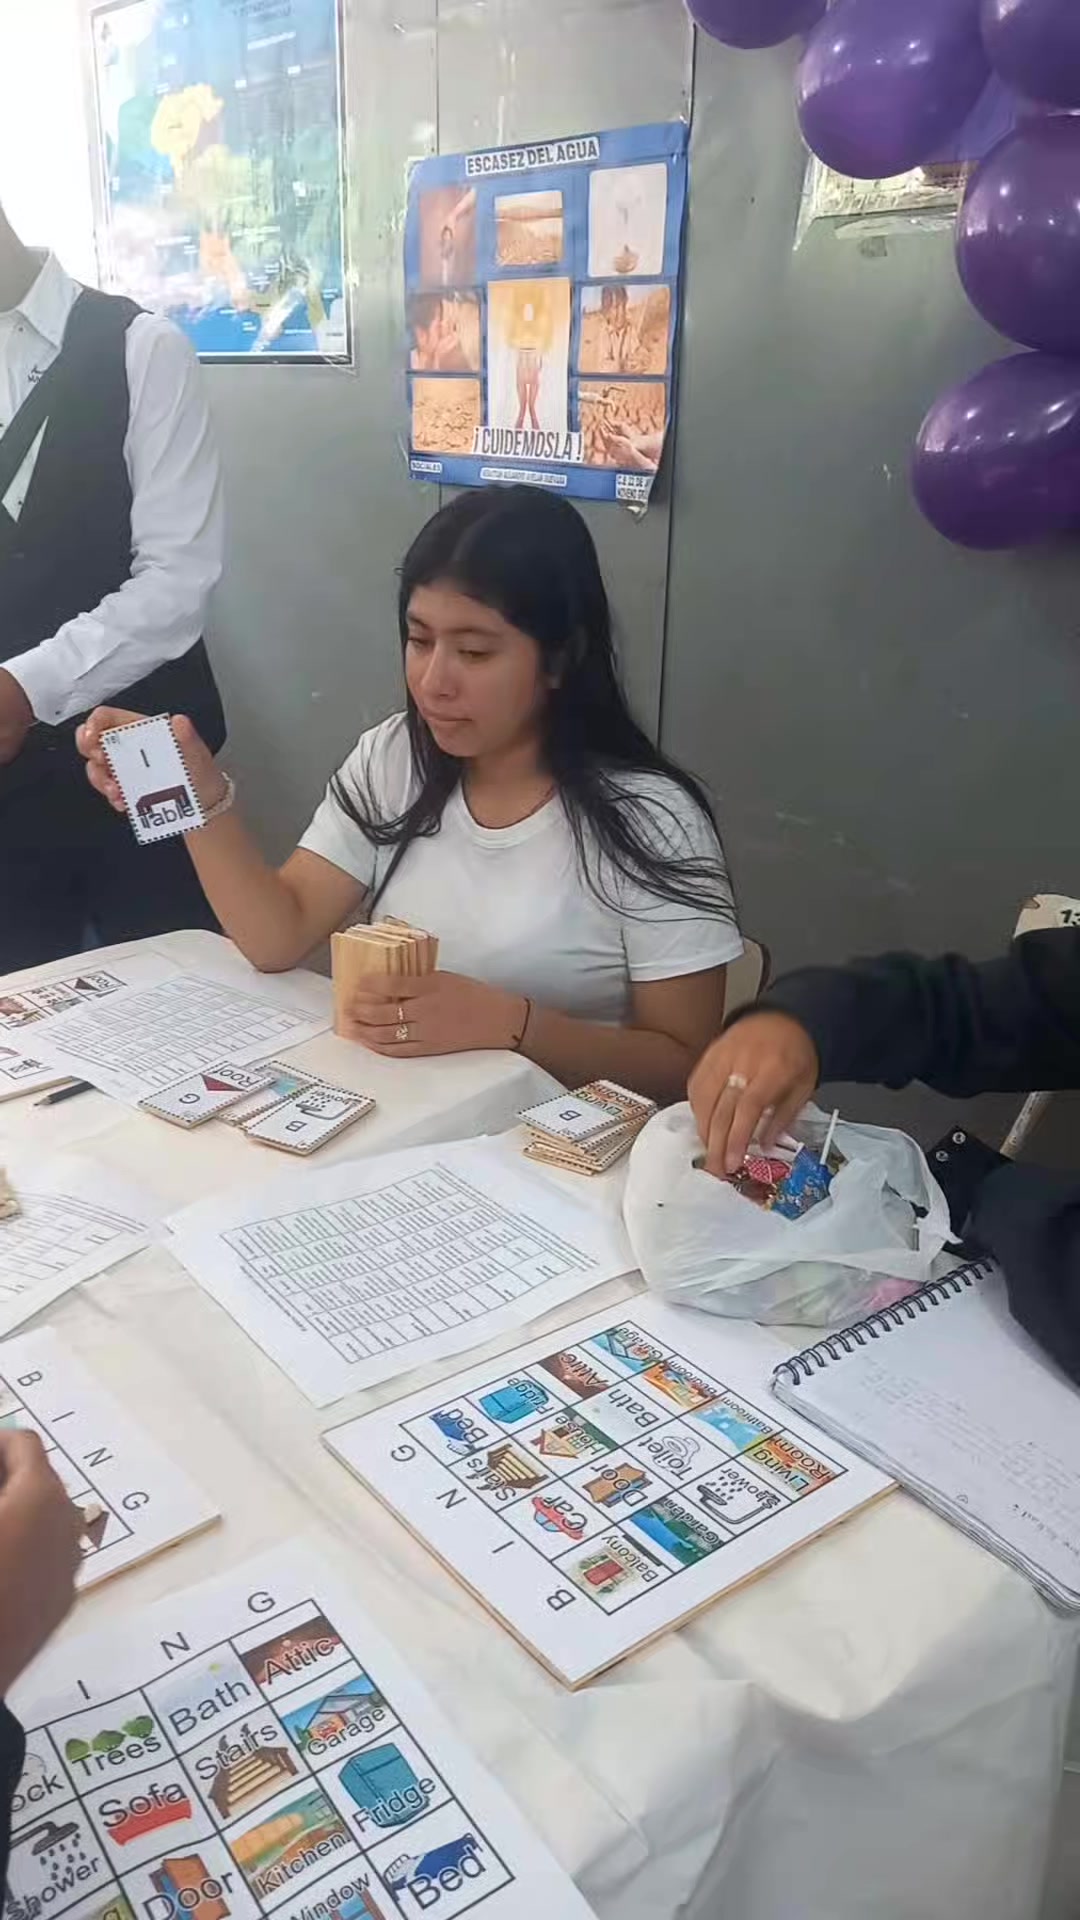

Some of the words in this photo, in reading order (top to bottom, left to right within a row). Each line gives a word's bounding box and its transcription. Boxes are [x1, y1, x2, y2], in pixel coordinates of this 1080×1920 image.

[467, 151, 525, 174] ESCASEZ
[527, 147, 553, 166] DEL
[556, 140, 598, 162] AGUA
[137, 797, 196, 830] Table
[211, 1065, 260, 1088] Roof
[178, 1092, 201, 1105] G
[559, 1109, 582, 1121] B
[285, 1119, 309, 1133] B
[620, 1327, 664, 1364] Garage
[559, 1351, 611, 1387] Attic
[507, 1376, 554, 1415] Fridge
[608, 1388, 660, 1429] Bath
[723, 1396, 774, 1435] Bathroom
[17, 1371, 43, 1387] B
[83, 1447, 113, 1468] N
[122, 1491, 149, 1511] G
[441, 1407, 489, 1444] Bed
[555, 1414, 606, 1456] House
[391, 1444, 416, 1462] G
[637, 1437, 693, 1480] Toilet
[752, 1448, 810, 1493] Living
[770, 1435, 831, 1480] Room
[436, 1488, 467, 1509] N
[467, 1457, 517, 1501] Stairs
[589, 1464, 648, 1507] Door
[720, 1467, 781, 1510] Shower
[542, 1495, 588, 1531] Car
[663, 1498, 723, 1546] Garden
[601, 1534, 658, 1583] Balcony
[547, 1588, 577, 1611] B
[160, 1631, 191, 1660] N
[247, 1591, 276, 1613] G
[264, 1637, 335, 1685] Attic
[168, 1681, 253, 1736] Bath
[195, 1722, 279, 1780] Stairs
[307, 1706, 387, 1756] Garage
[72, 1734, 162, 1777] Trees
[98, 1781, 188, 1828] Sofa
[352, 1776, 437, 1833] Fridge
[255, 1831, 346, 1896] Kitchen
[407, 1844, 487, 1910] Bed
[143, 1870, 234, 1920] Door
